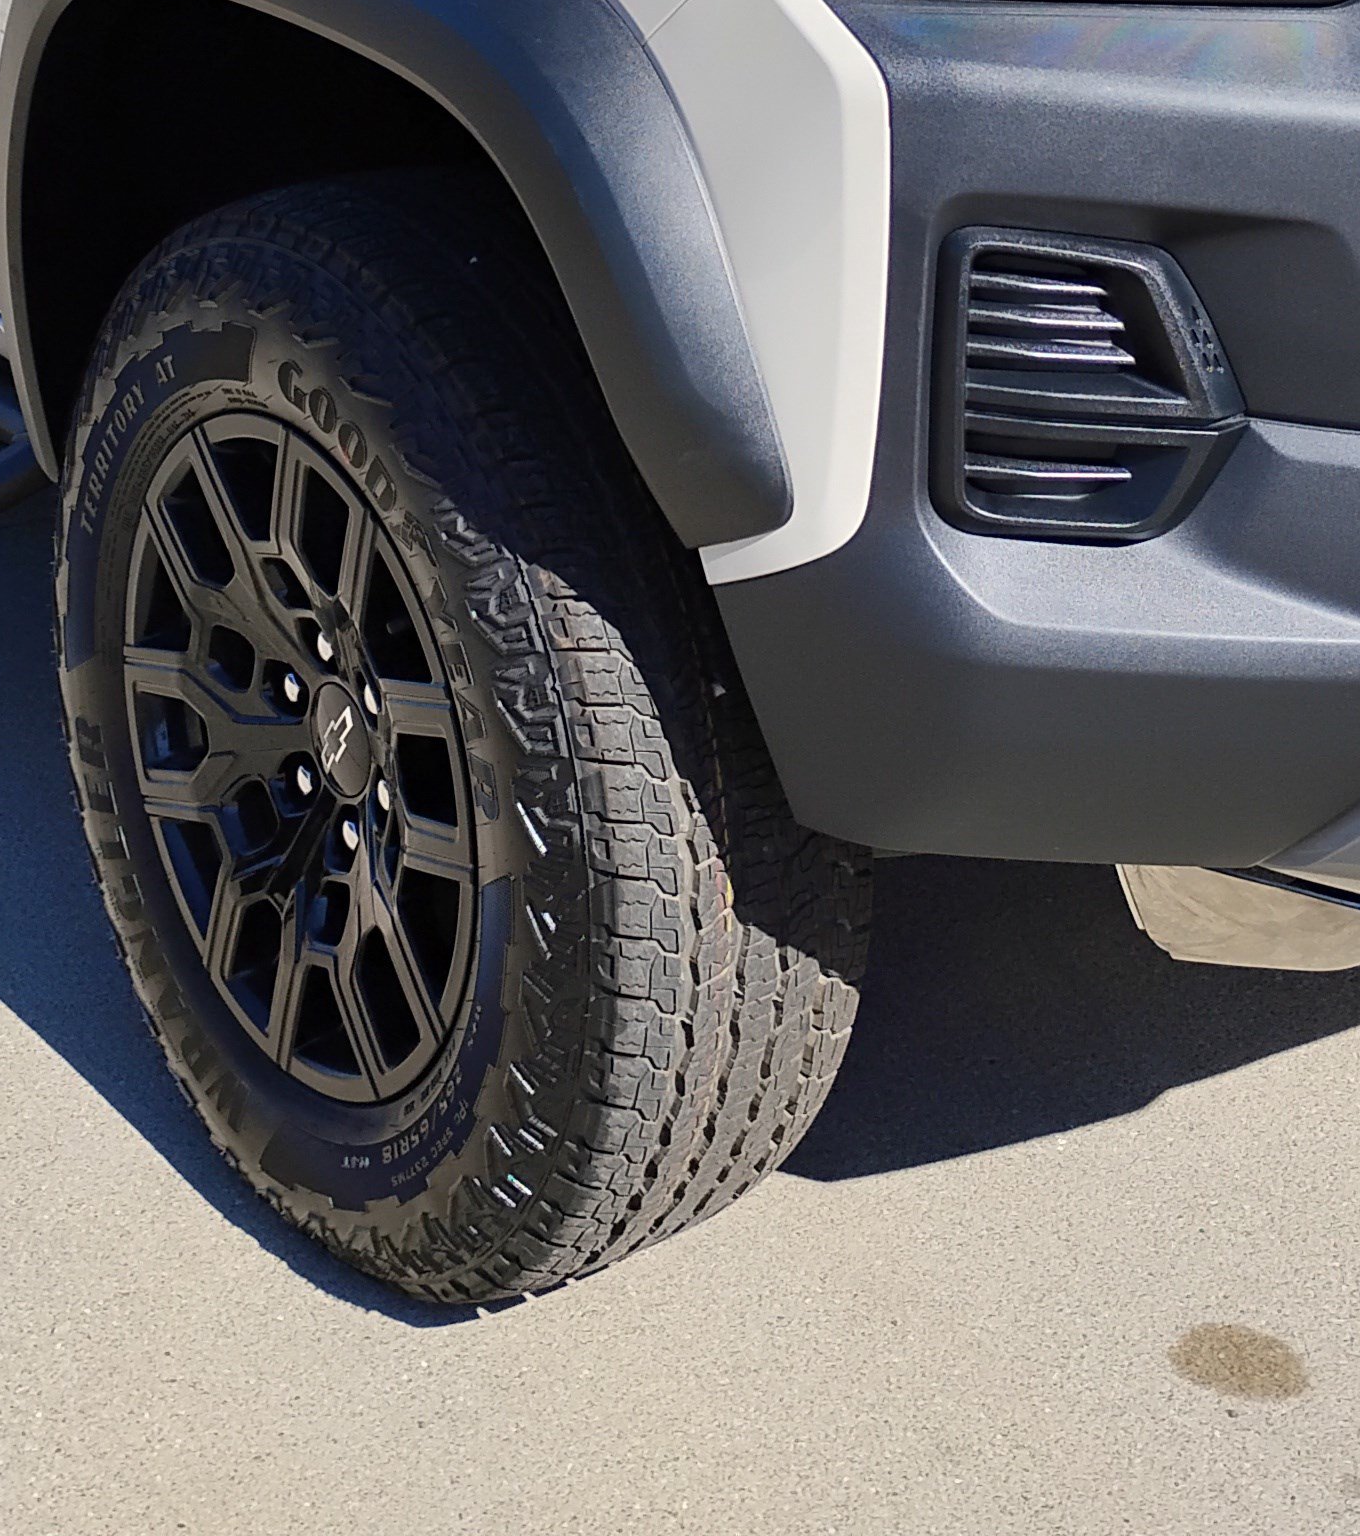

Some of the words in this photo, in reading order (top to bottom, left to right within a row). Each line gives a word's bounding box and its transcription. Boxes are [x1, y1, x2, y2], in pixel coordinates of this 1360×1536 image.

[79, 382, 146, 537] TERRITORY
[155, 354, 179, 386] AT
[276, 357, 501, 823] GOODYEAR
